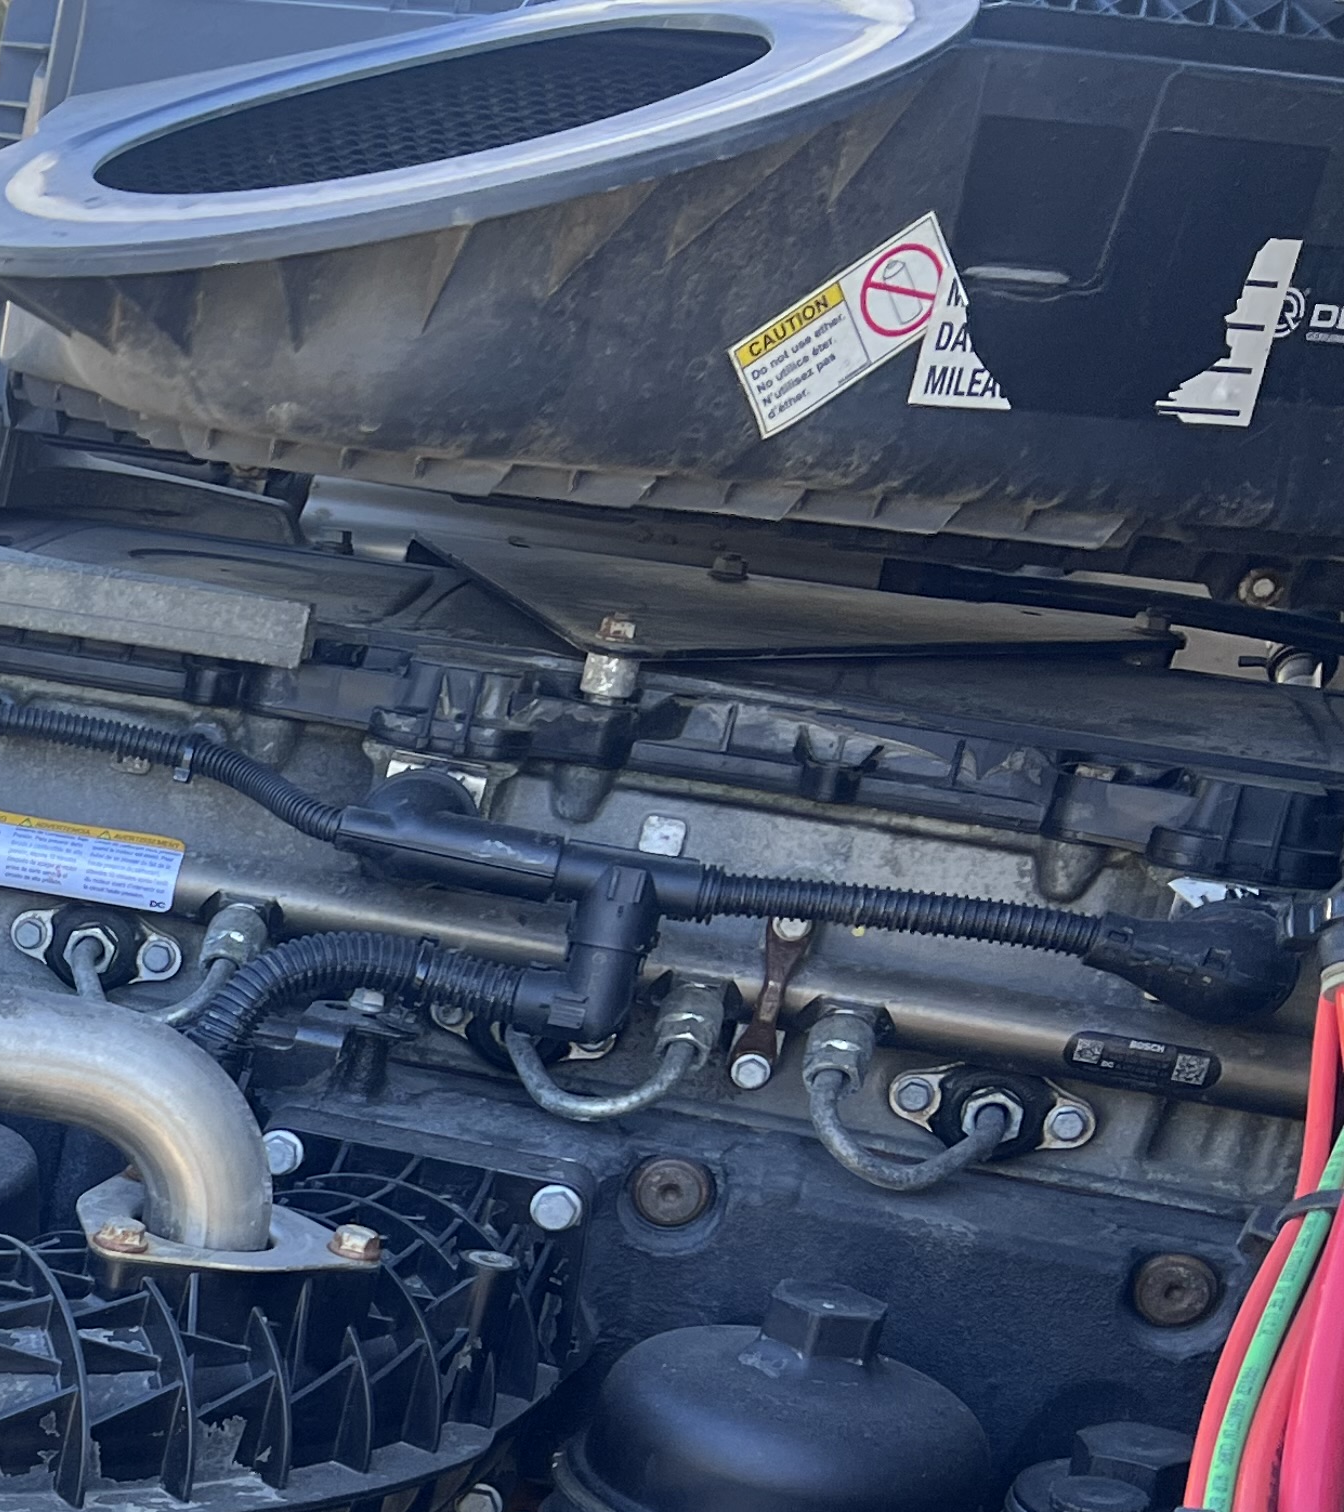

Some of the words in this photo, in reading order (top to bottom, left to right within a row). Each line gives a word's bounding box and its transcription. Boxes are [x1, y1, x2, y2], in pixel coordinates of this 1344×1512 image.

[947, 278, 965, 307] M
[749, 294, 829, 357] CAUTION
[1309, 303, 1344, 330] D
[751, 364, 768, 380] Do
[770, 350, 789, 368] not
[791, 335, 812, 353] use
[814, 314, 846, 338] ether.
[935, 321, 972, 352] DA
[757, 380, 773, 394] No
[775, 355, 810, 381] utilice
[817, 353, 836, 373] pas
[924, 365, 996, 398] MILEA
[150, 900, 166, 909] DC
[1129, 1040, 1165, 1053] BOSCH
